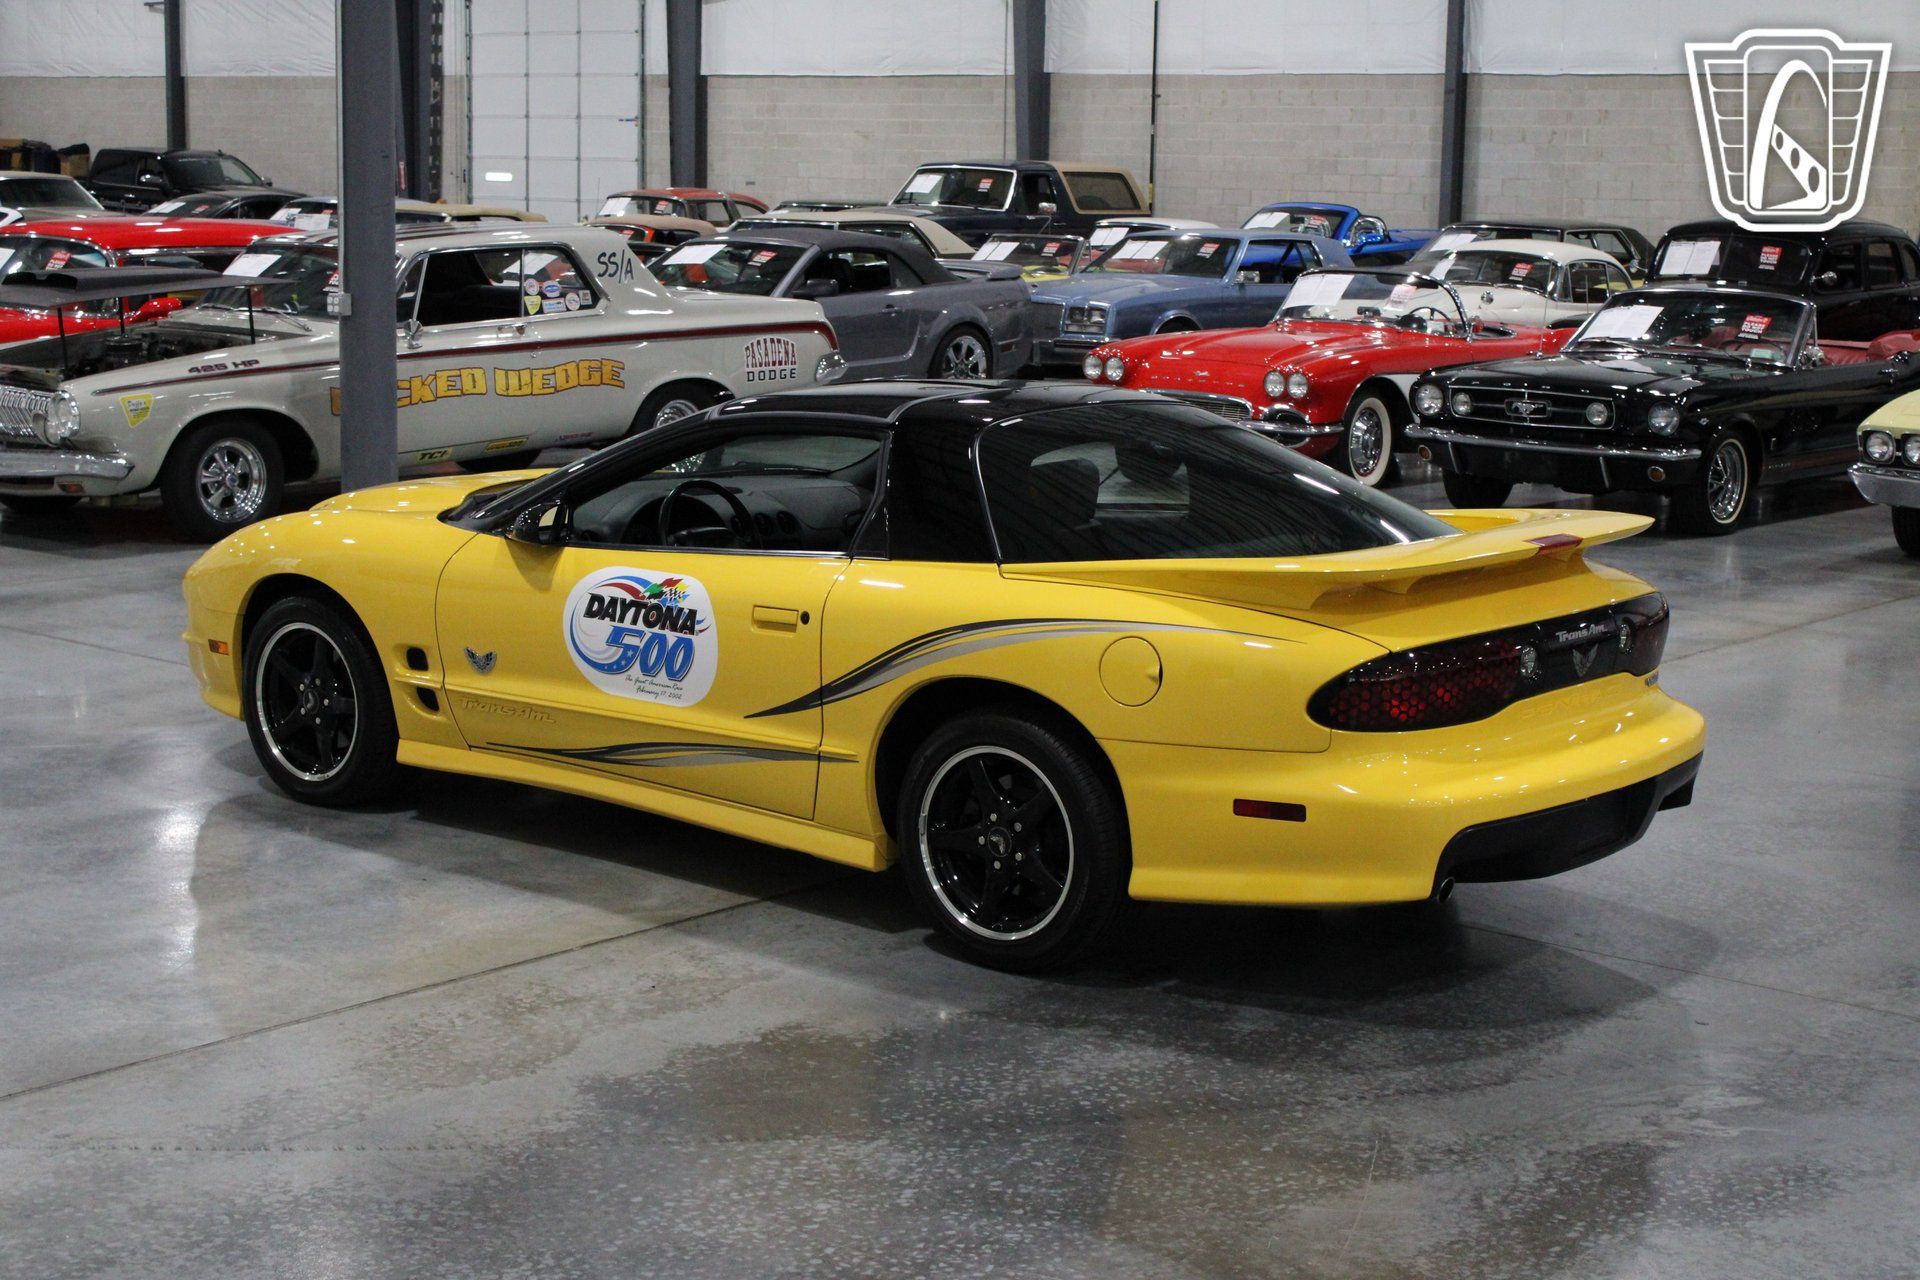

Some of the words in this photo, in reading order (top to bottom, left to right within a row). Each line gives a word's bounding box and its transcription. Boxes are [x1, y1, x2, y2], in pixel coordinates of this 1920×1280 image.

[598, 249, 634, 284] SS/A
[232, 359, 260, 369] HP
[745, 337, 796, 368] PASADENA
[494, 358, 625, 397] WEDGE
[746, 368, 796, 382] DODGE
[583, 592, 698, 636] DAYTONA
[604, 625, 695, 682] 500
